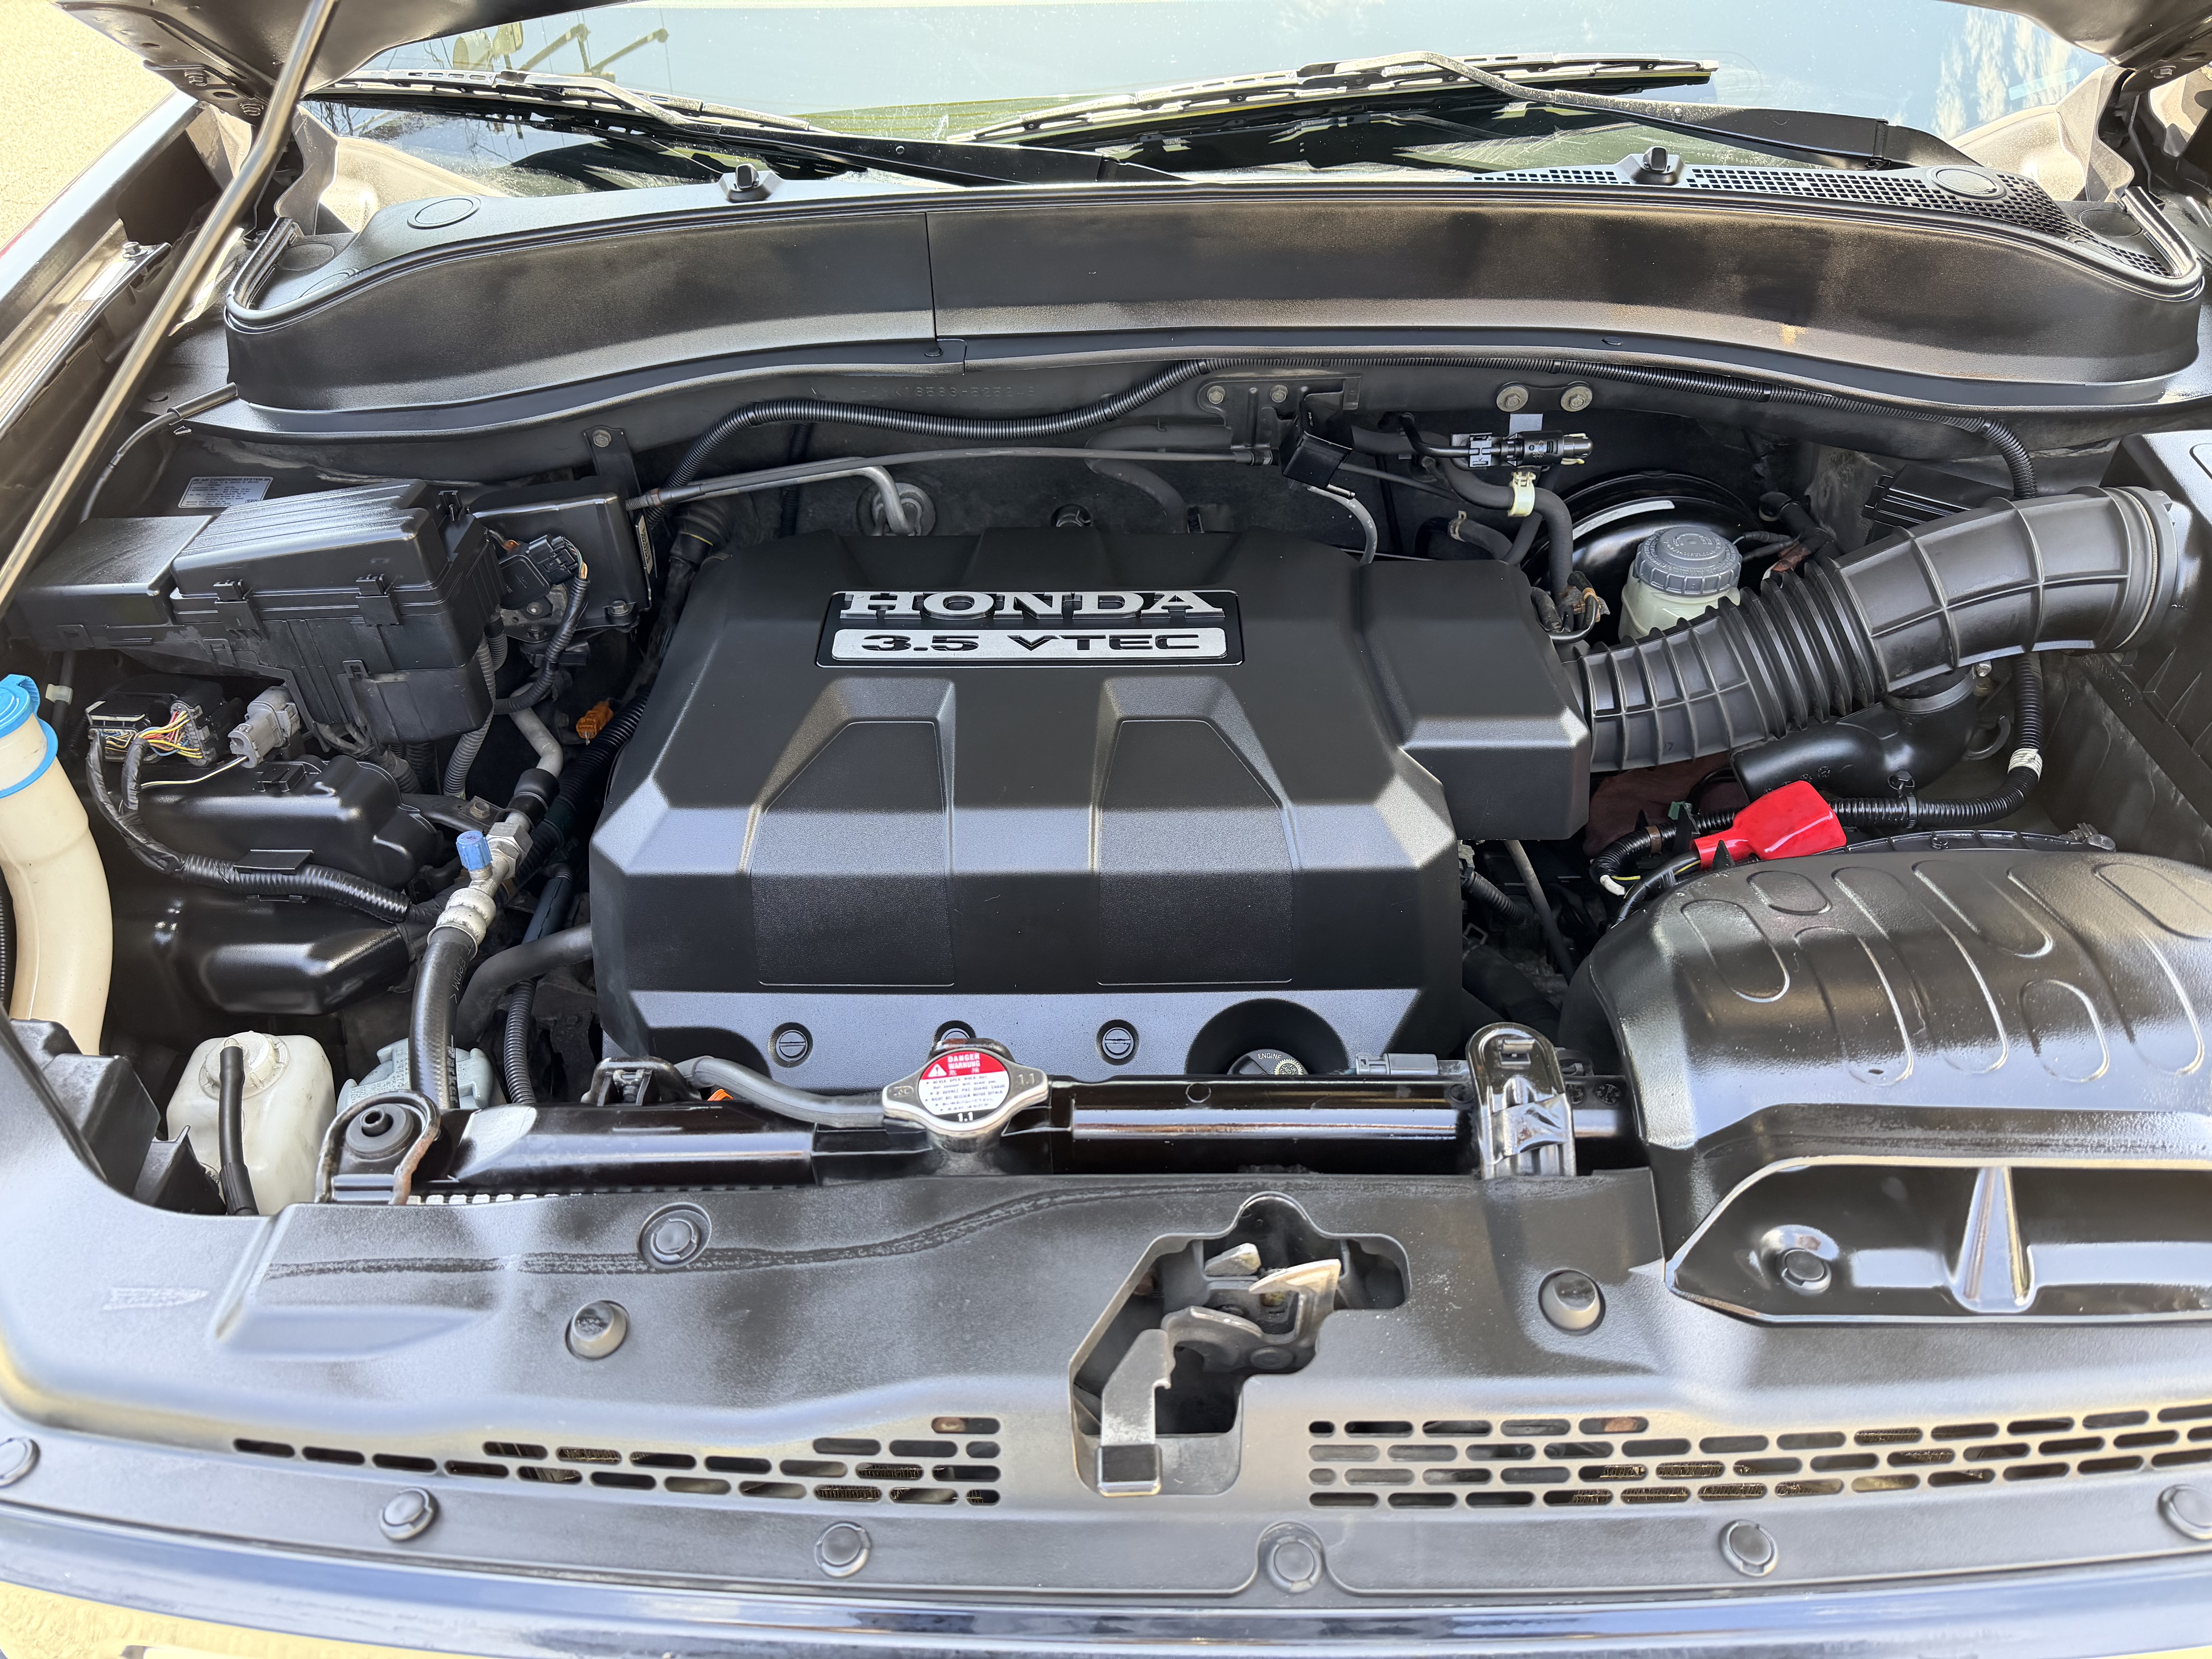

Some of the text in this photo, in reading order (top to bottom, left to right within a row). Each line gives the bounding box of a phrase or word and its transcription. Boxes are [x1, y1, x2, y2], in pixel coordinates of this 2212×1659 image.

[840, 591, 1225, 620] HONDA
[861, 634, 1200, 651] 3.5 VTEC
[948, 1053, 980, 1063] DANGER
[948, 1060, 980, 1070] WARNUNG
[1017, 1073, 1034, 1085] 1.1
[958, 1111, 973, 1122] 1.1
